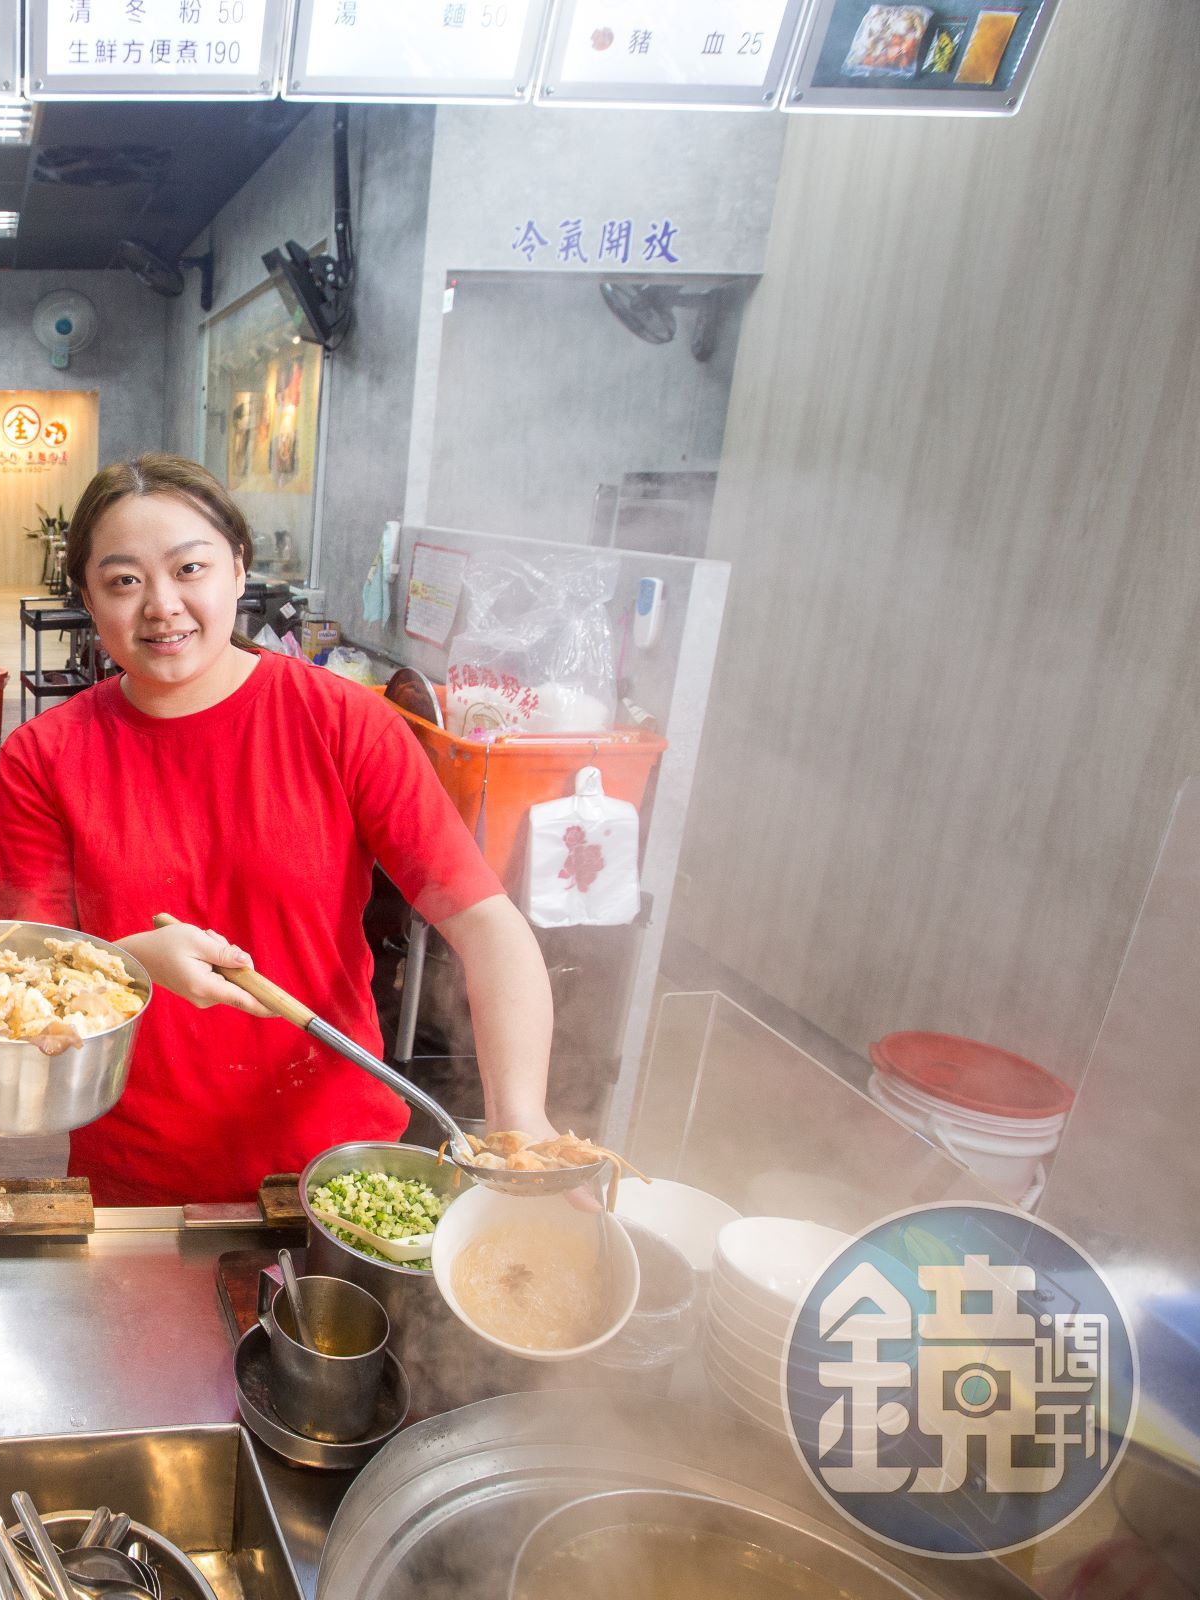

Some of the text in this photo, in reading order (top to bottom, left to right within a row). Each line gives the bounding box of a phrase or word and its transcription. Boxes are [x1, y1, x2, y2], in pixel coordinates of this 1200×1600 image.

[737, 31, 765, 55] 25
[511, 218, 680, 264] 冷氣開放
